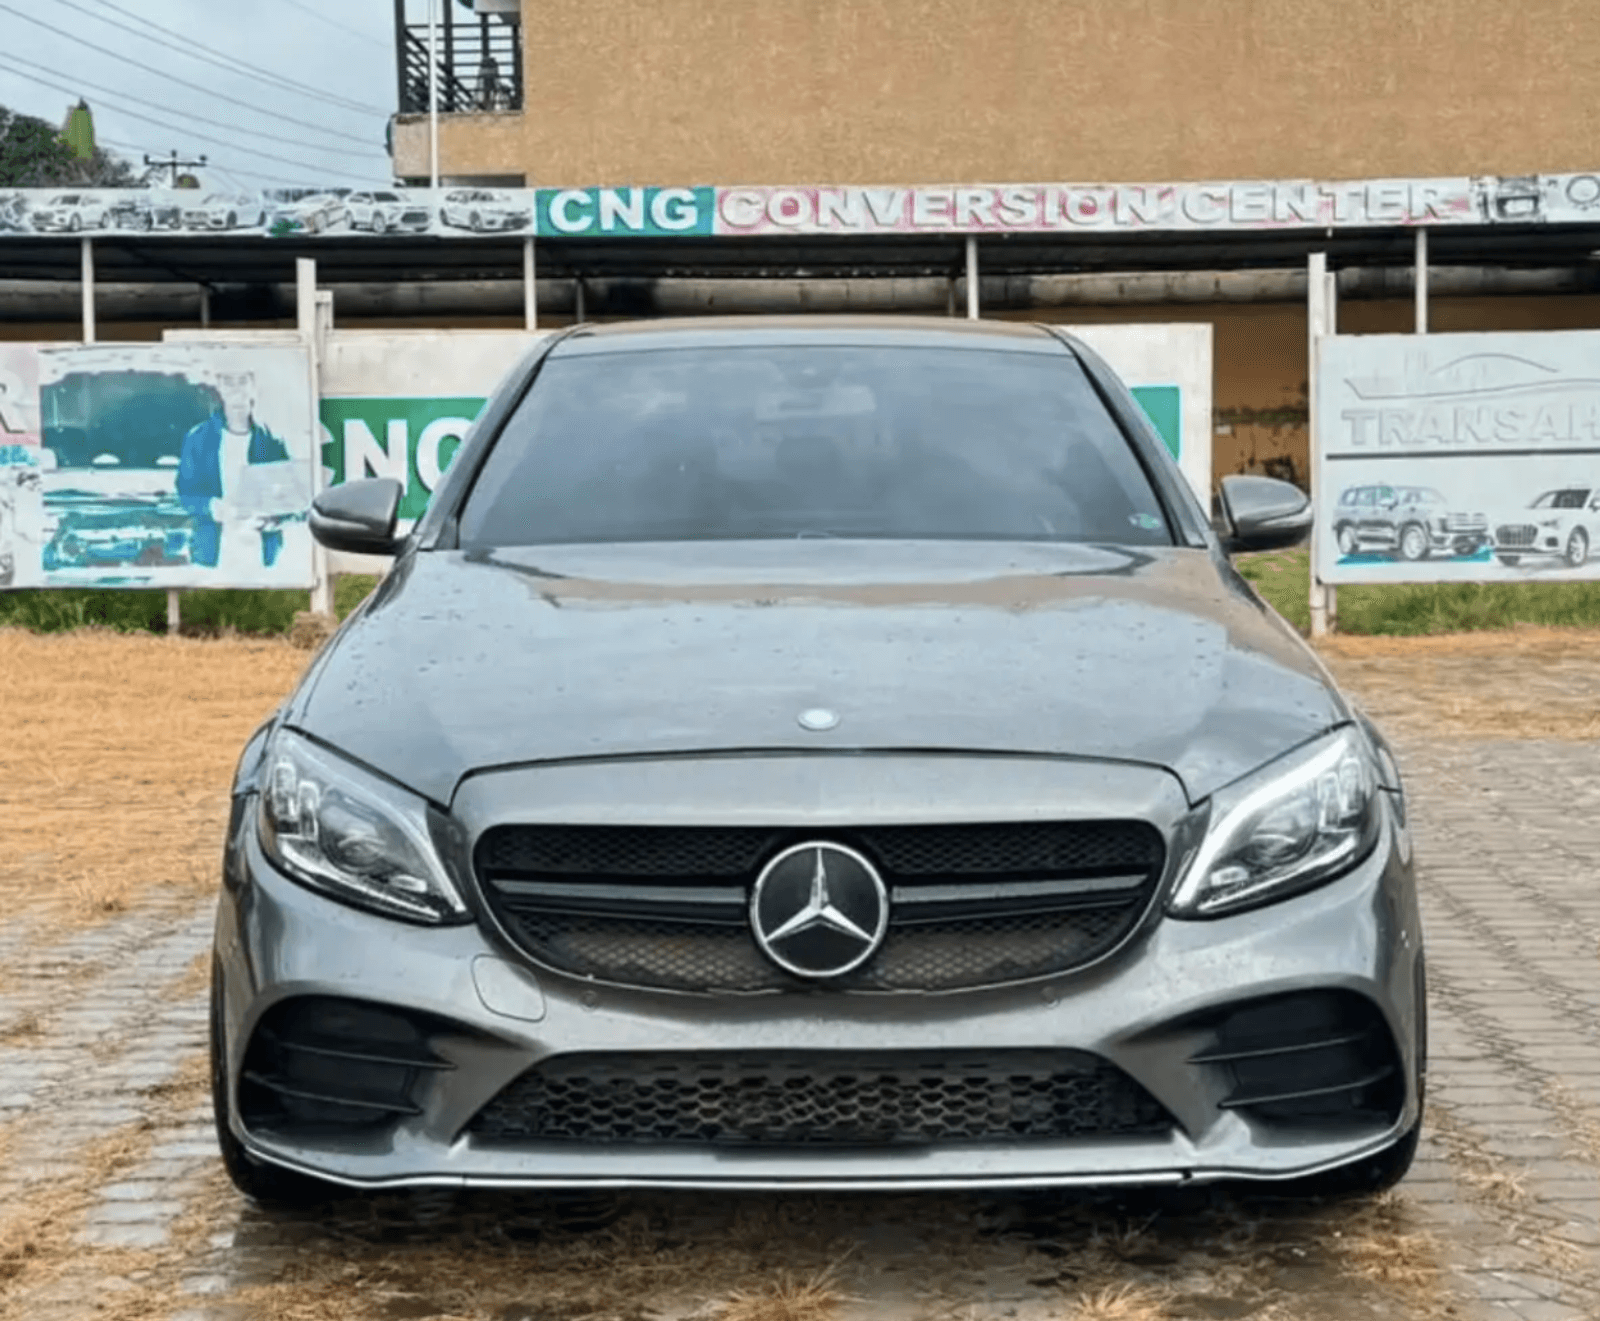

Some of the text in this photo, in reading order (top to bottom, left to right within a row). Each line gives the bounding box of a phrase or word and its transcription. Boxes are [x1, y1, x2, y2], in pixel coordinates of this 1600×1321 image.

[549, 180, 1450, 231] CNG CONVERSION CENTER
